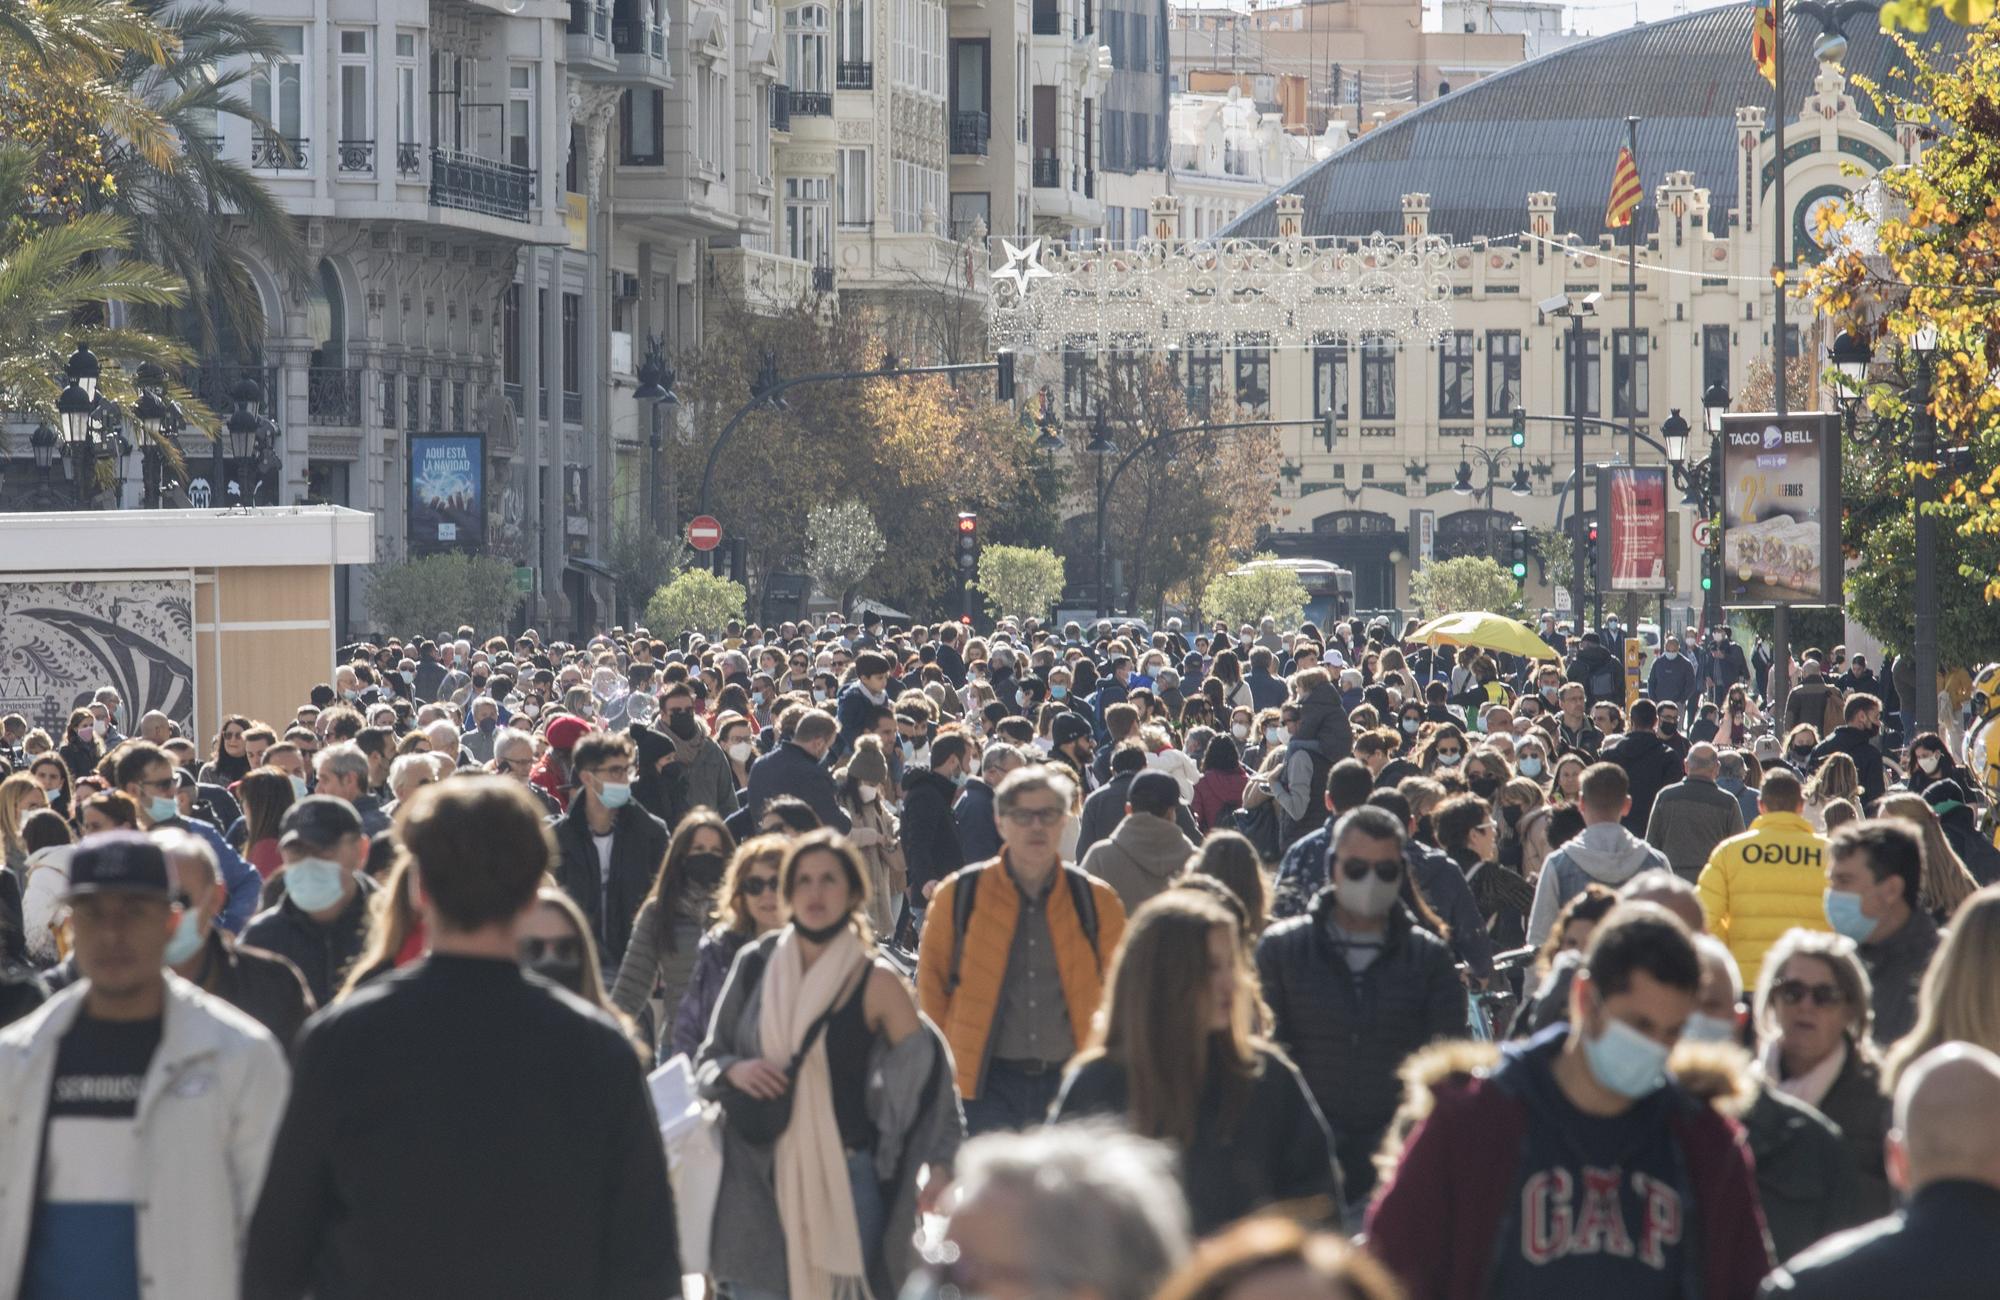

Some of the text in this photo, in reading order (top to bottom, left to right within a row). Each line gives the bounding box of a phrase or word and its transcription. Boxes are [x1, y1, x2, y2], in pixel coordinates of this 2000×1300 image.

[1729, 430, 1813, 445] TACO BELL
[425, 445, 467, 459] AQUÍ ESTÁ
[422, 459, 471, 471] LA NAVIDAD
[1521, 1165, 1683, 1270] GAP
